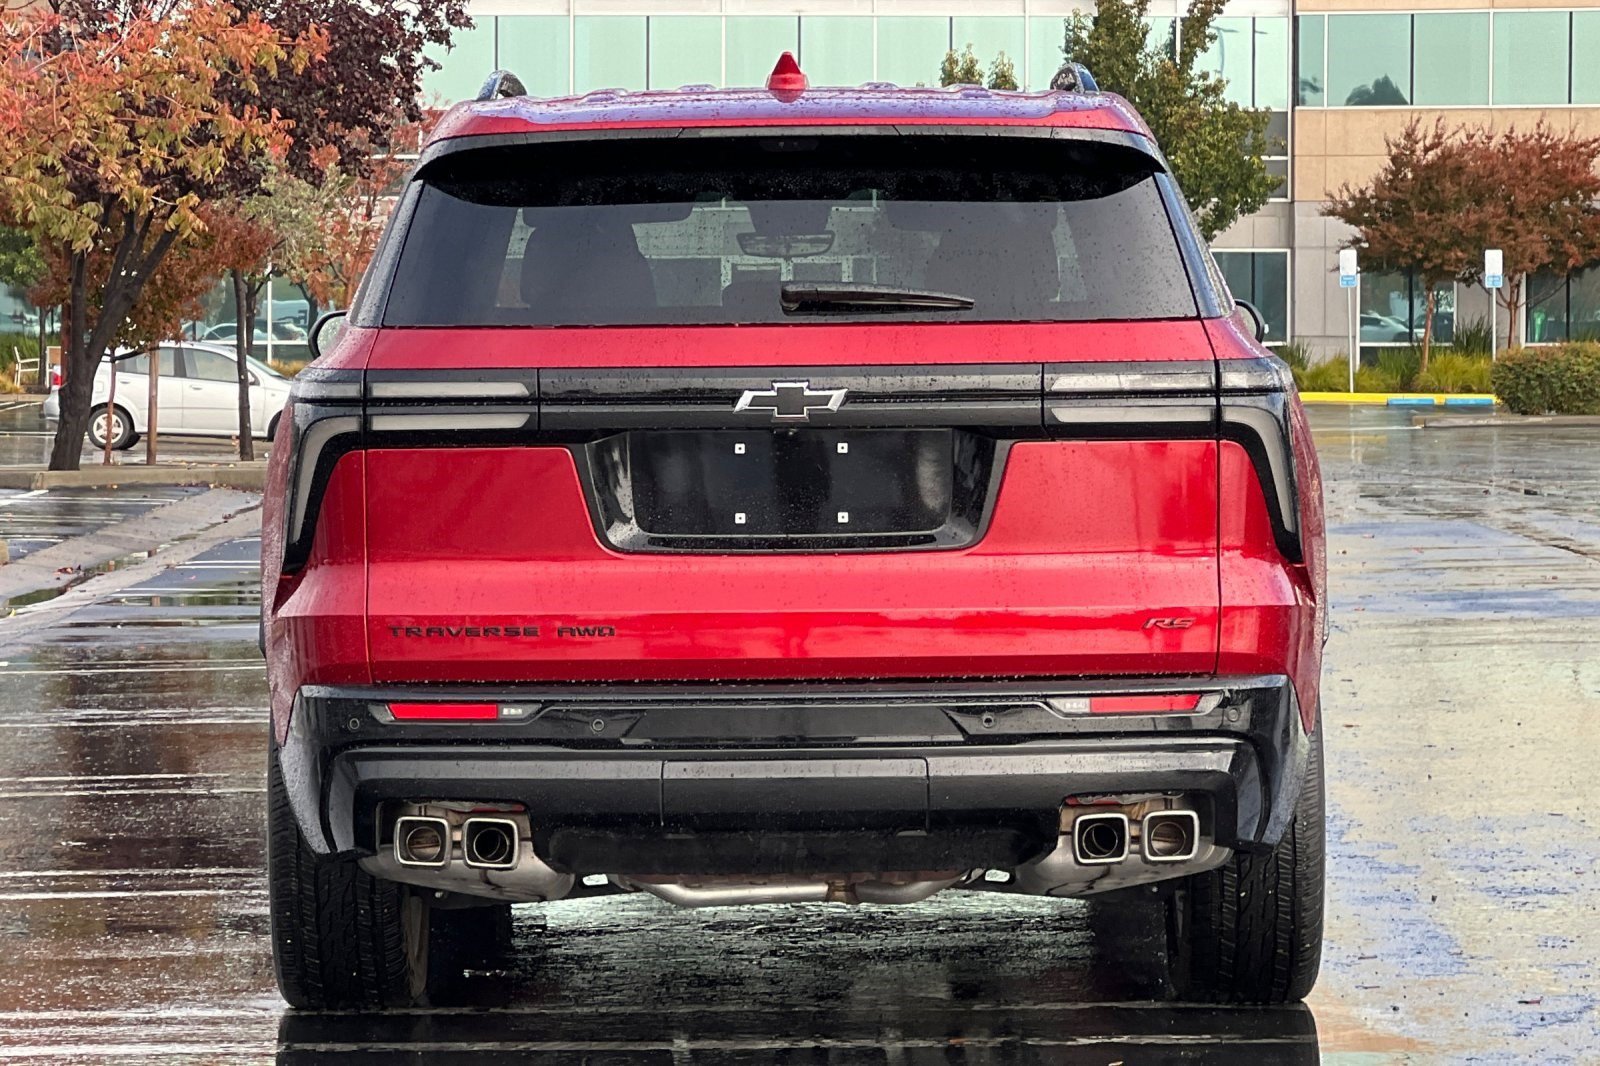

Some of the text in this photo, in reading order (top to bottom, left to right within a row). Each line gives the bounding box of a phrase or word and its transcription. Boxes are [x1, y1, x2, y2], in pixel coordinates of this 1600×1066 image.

[1141, 617, 1196, 630] RS
[389, 625, 616, 638] TRAVERSE AWD
